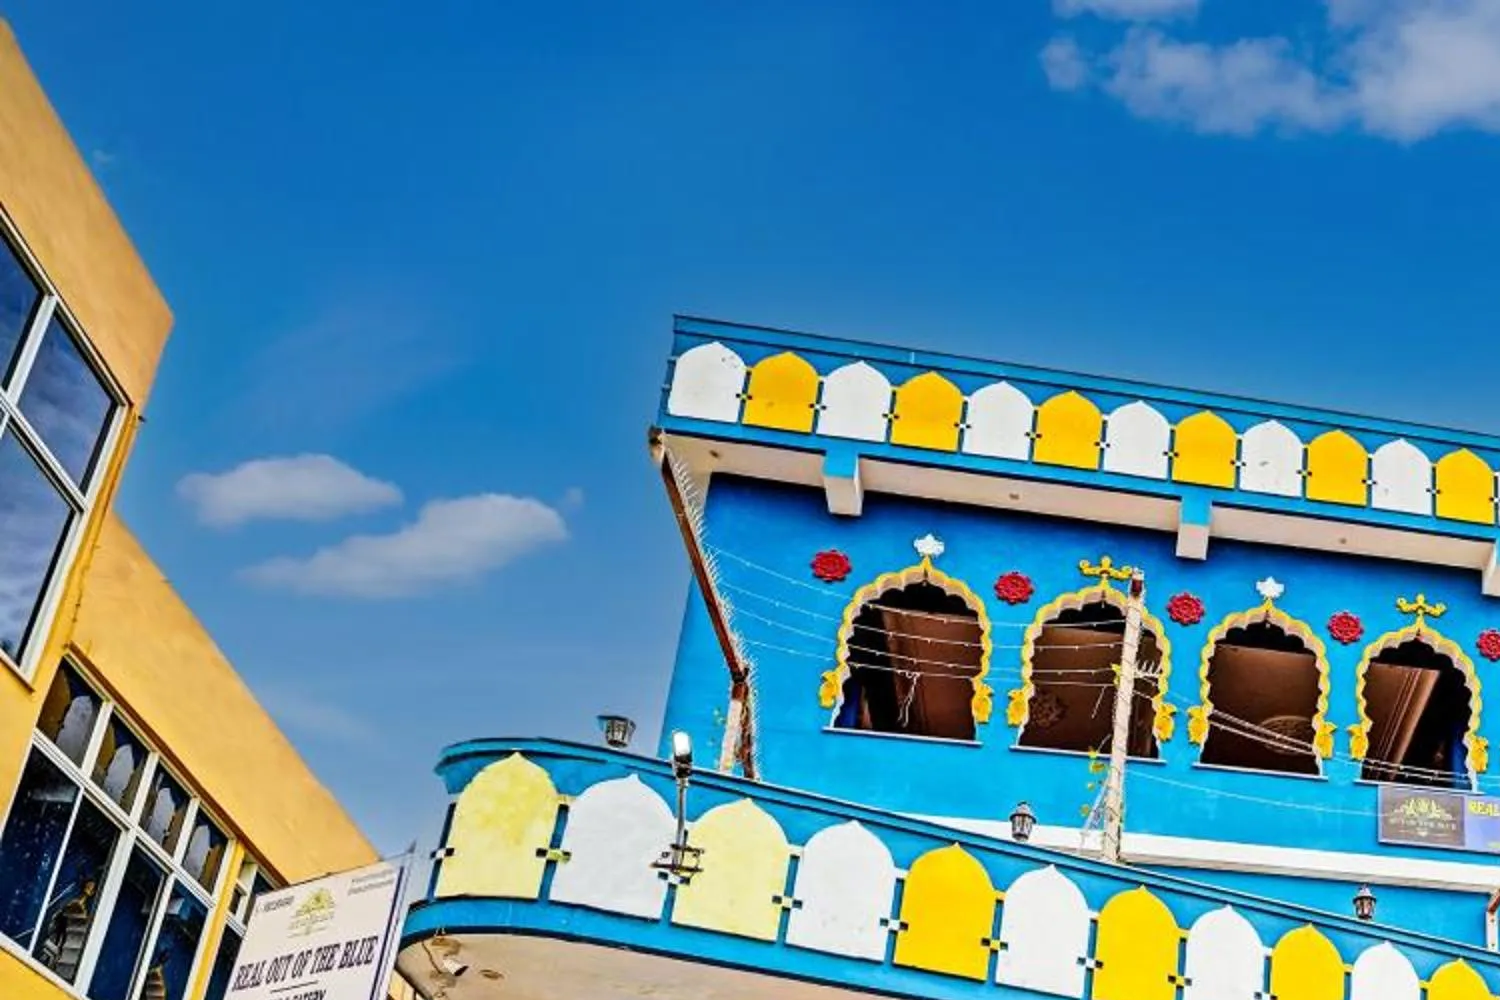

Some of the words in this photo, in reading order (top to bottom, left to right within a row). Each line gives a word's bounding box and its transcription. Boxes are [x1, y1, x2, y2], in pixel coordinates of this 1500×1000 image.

[1467, 800, 1500, 817] REAL
[232, 960, 267, 992] REAL
[265, 954, 294, 985] OUT
[291, 949, 312, 979] OF
[310, 943, 341, 975] THE
[338, 935, 378, 969] BLUE
